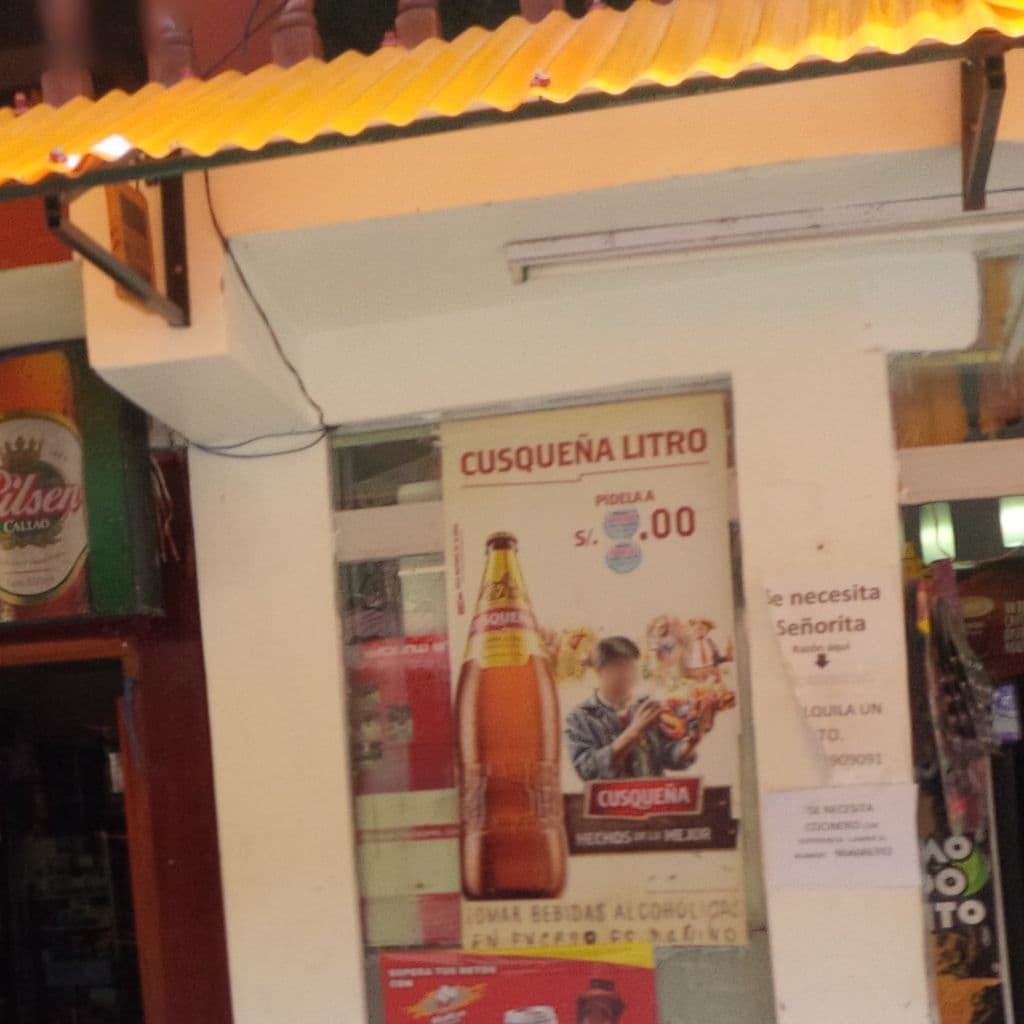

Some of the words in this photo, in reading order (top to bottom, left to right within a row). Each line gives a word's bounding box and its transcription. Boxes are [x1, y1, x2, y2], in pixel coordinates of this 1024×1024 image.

[460, 433, 615, 476] CUSQUEÑA
[623, 428, 707, 460] LITRO
[790, 584, 881, 606] necesita
[776, 614, 866, 636] Señorita
[597, 784, 690, 809] CUSQUEÑA
[532, 903, 606, 923] BEBIDAS
